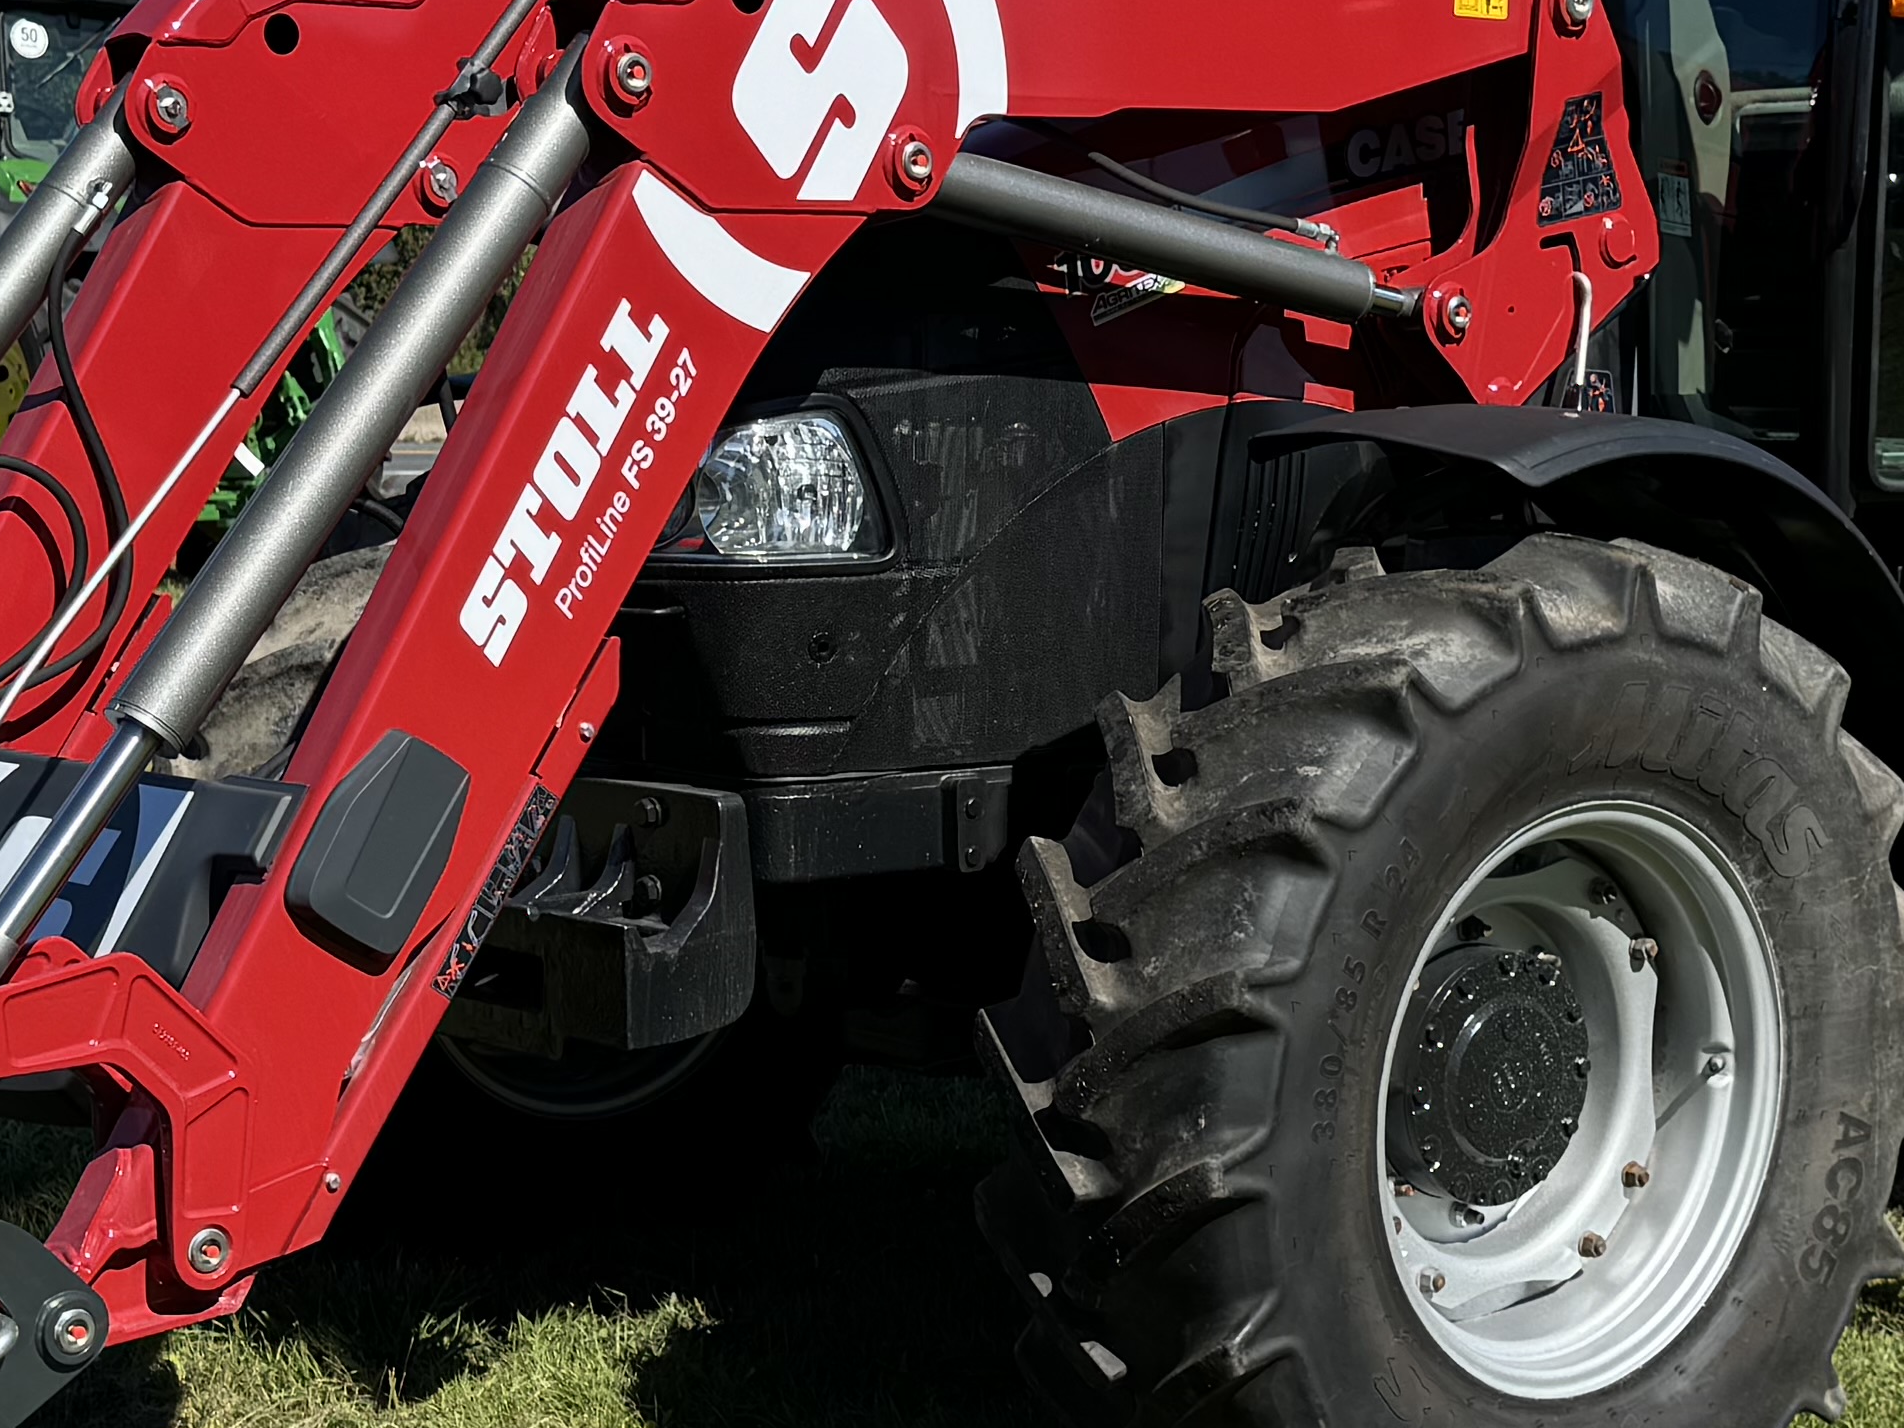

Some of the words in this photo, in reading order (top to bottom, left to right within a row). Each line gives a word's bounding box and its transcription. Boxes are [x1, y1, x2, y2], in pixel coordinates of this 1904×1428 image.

[21, 27, 38, 43] 50
[459, 297, 671, 668] STOLL
[554, 490, 631, 620] ProfiLine
[620, 439, 655, 490] FS
[645, 347, 698, 442] 39-27
[1311, 955, 1366, 1146] 380/85
[1360, 908, 1387, 940] R
[1385, 836, 1421, 893] 24
[1797, 1111, 1872, 1286] AC85
